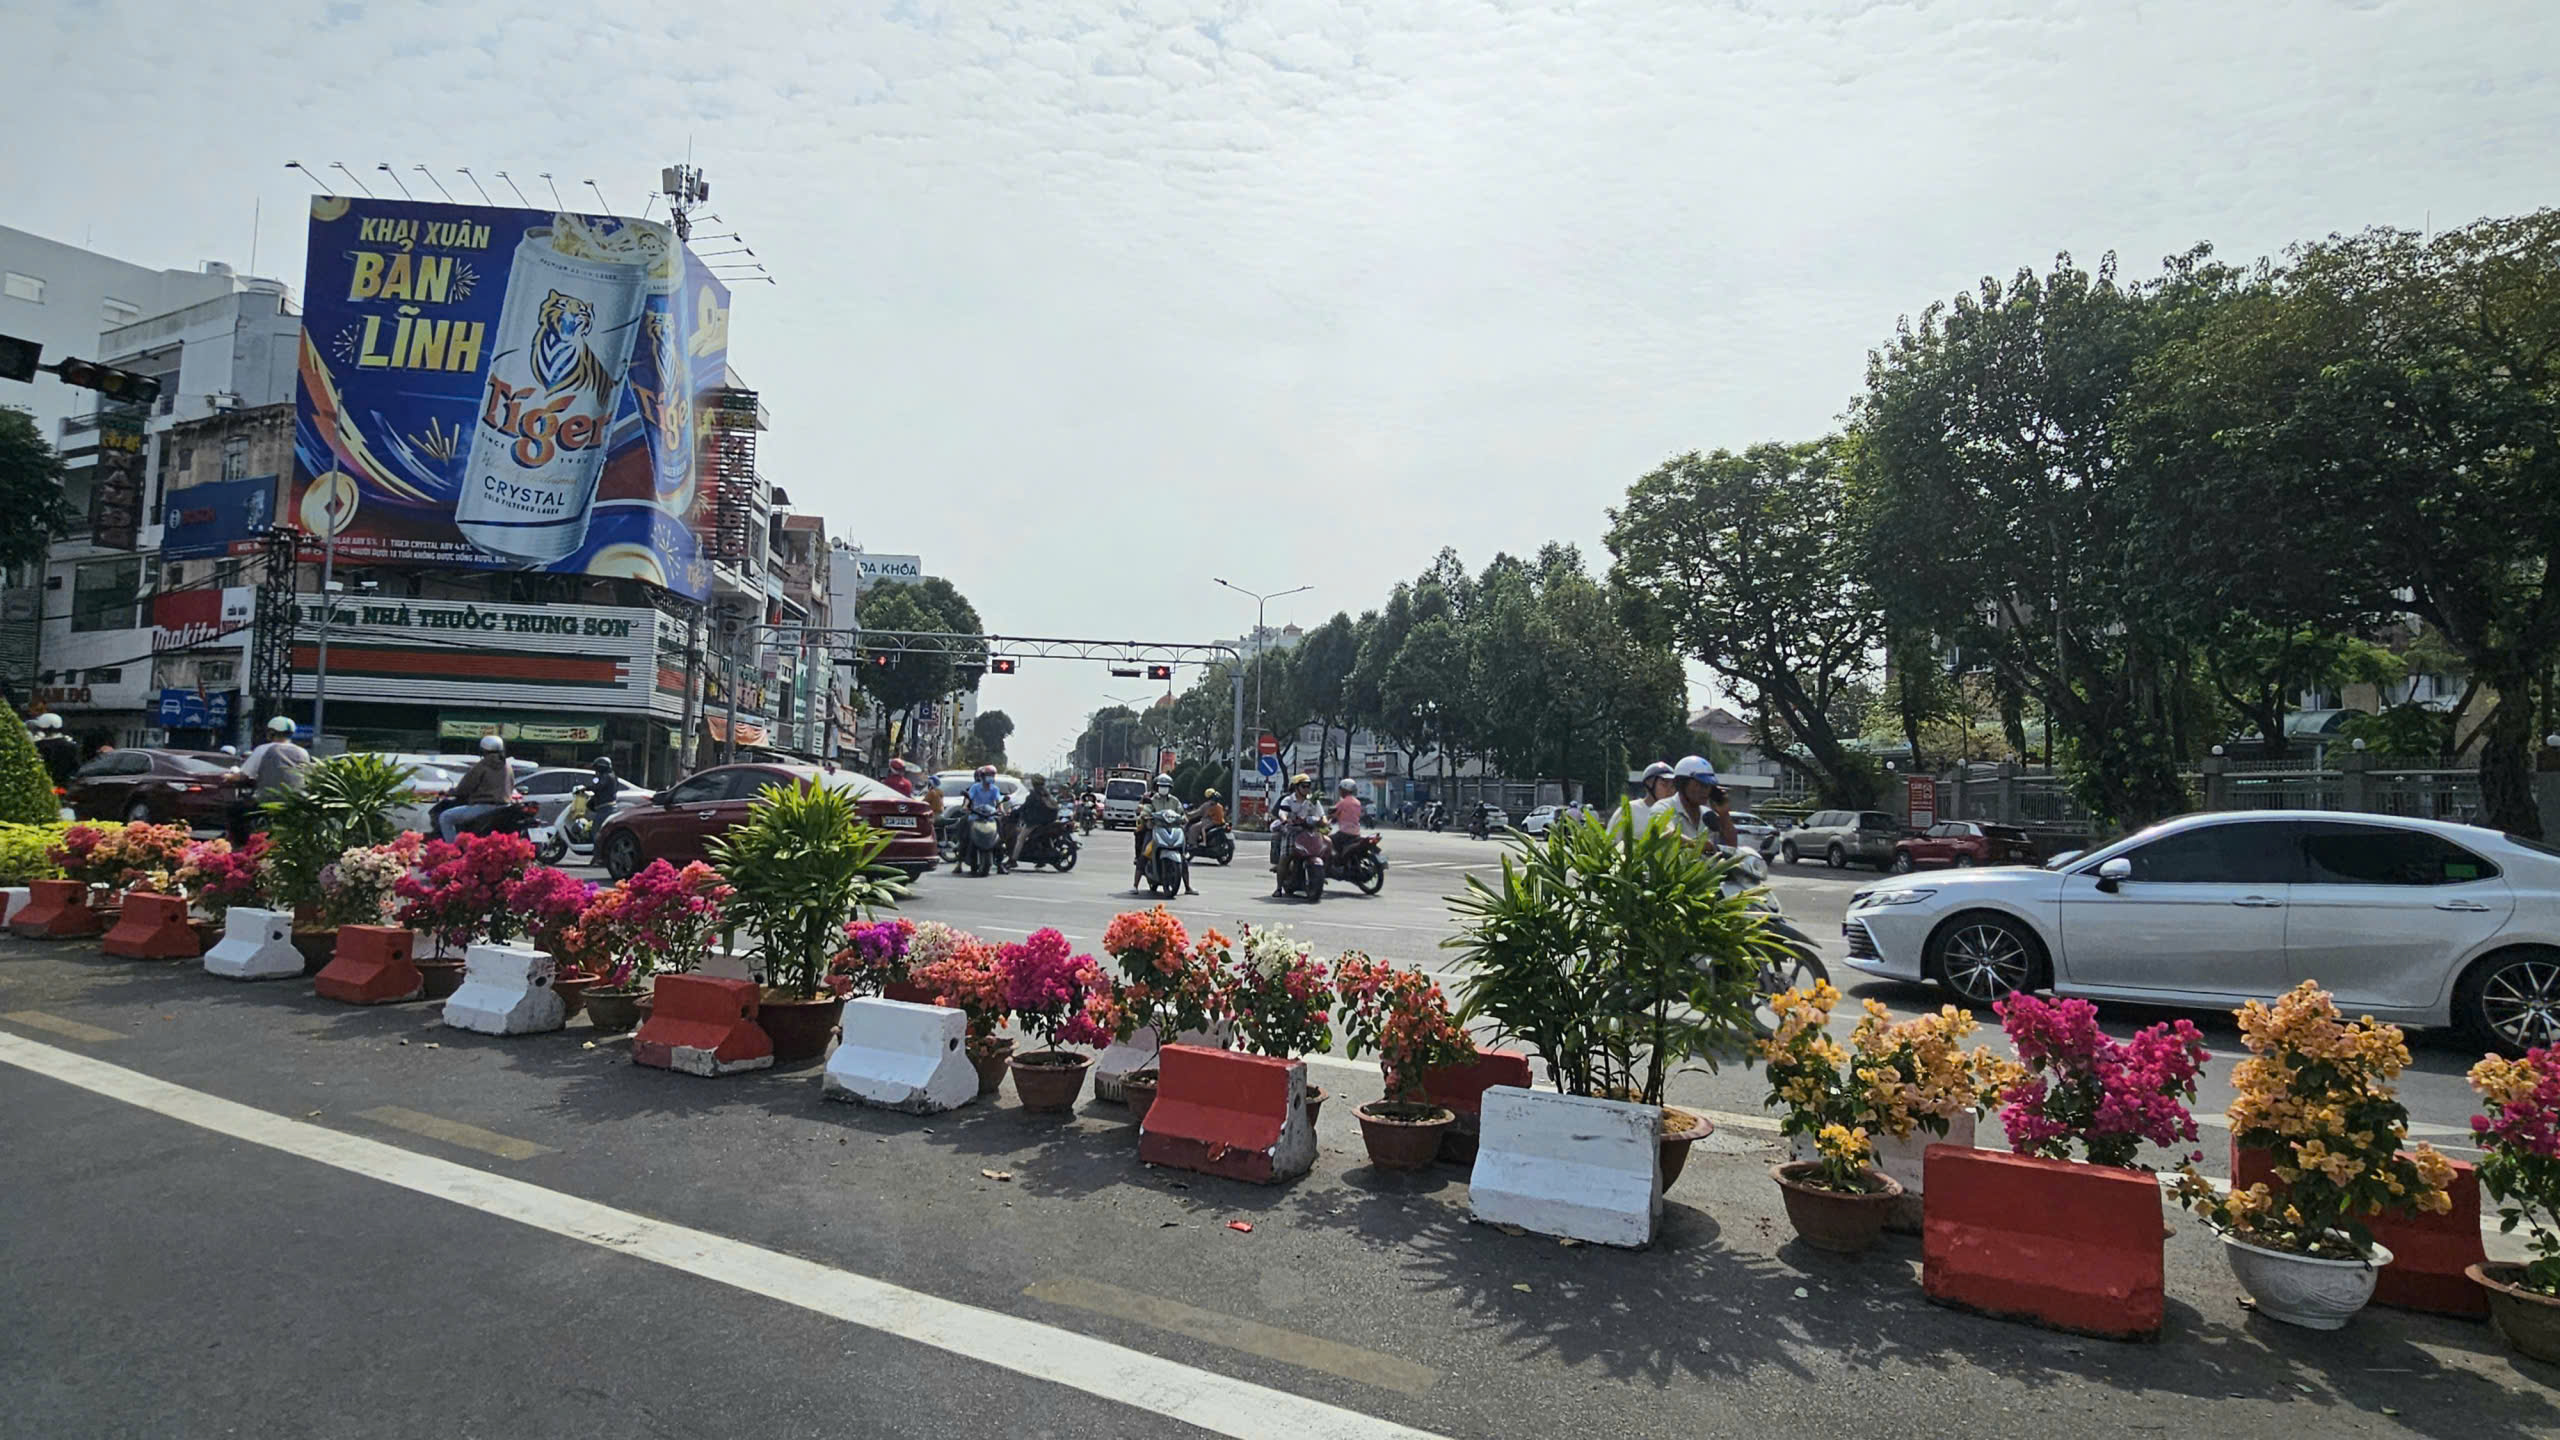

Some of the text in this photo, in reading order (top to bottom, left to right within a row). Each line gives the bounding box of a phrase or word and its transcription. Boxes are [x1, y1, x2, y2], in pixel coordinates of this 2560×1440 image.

[360, 218, 490, 248] KHAI XUÂN
[349, 239, 453, 303] BẢN
[357, 305, 485, 373] LĨNH
[482, 373, 613, 469] Tiger
[484, 475, 566, 507] CRYSTAL
[391, 539, 409, 548] TIGER
[410, 540, 438, 550] CRYSTAL
[363, 603, 412, 625] NHÀ
[418, 604, 496, 631] THUỐC
[503, 613, 578, 635] TRUNG
